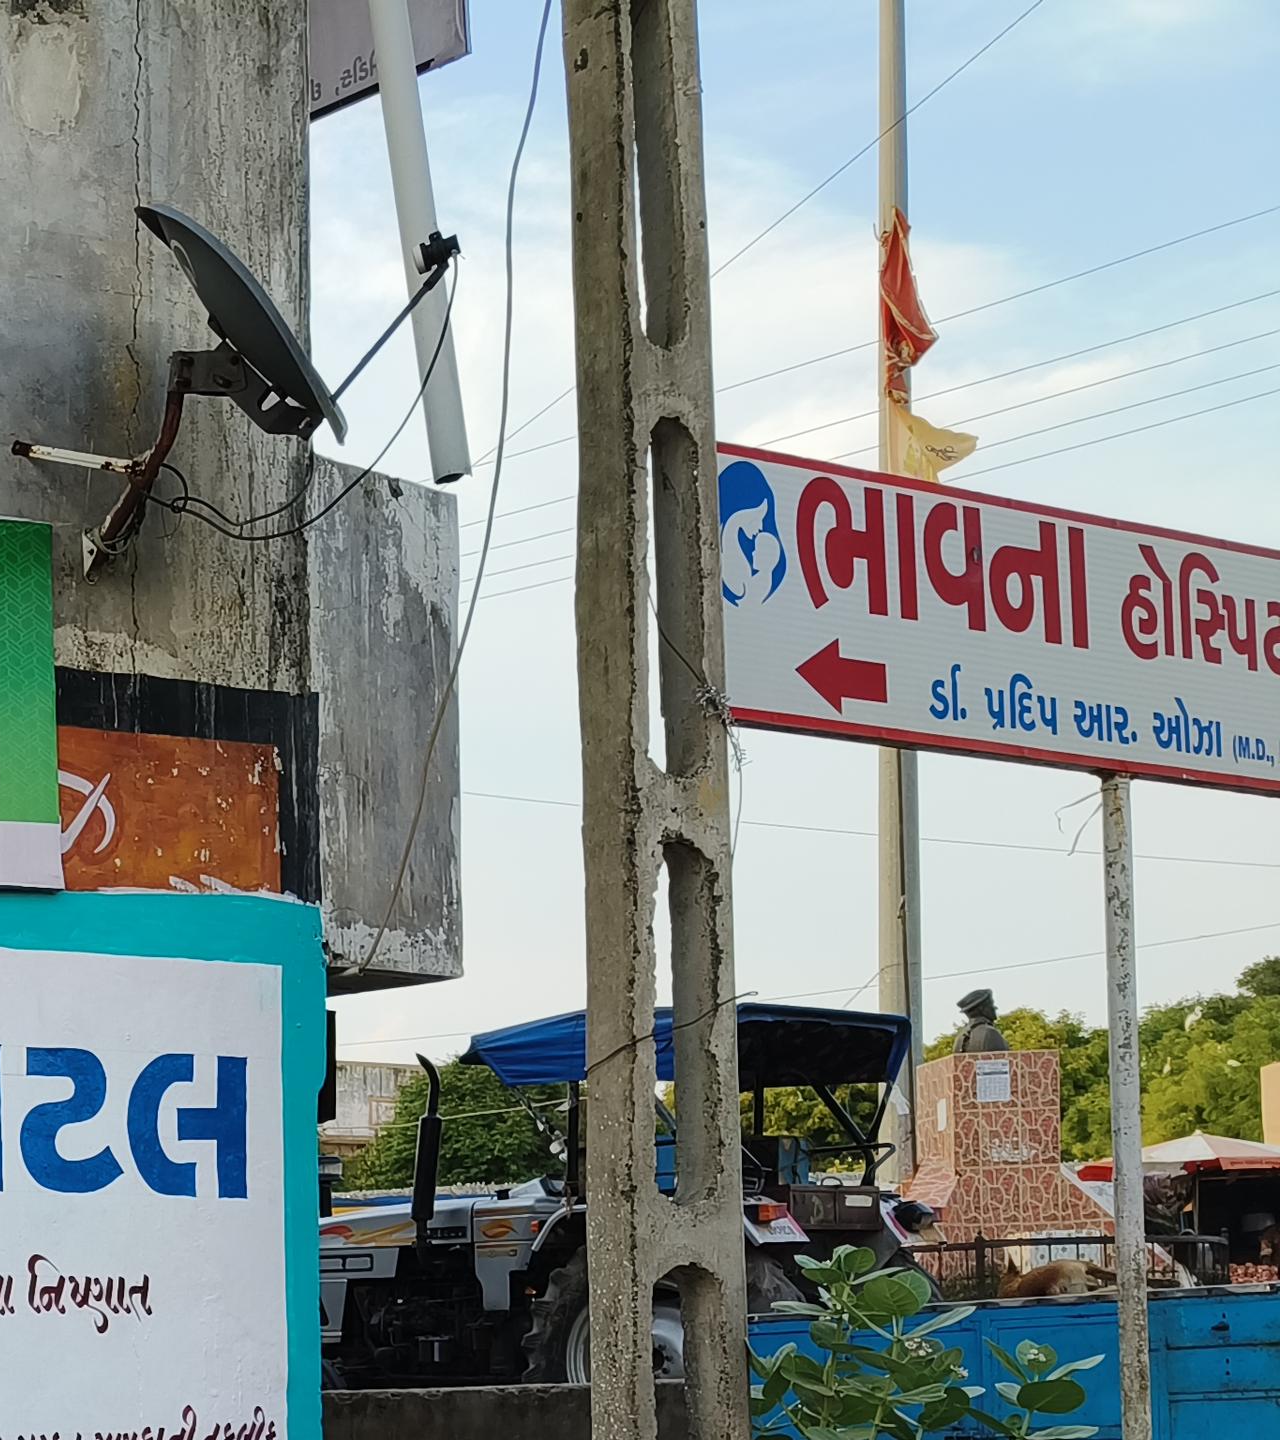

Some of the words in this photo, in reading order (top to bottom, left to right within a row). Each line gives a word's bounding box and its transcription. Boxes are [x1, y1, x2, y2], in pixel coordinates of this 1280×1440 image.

[796, 476, 1090, 649] ભાવના
[986, 673, 1057, 735] પ્રદિપ
[1074, 701, 1137, 745] આર.
[1153, 699, 1222, 755] ઓઝા
